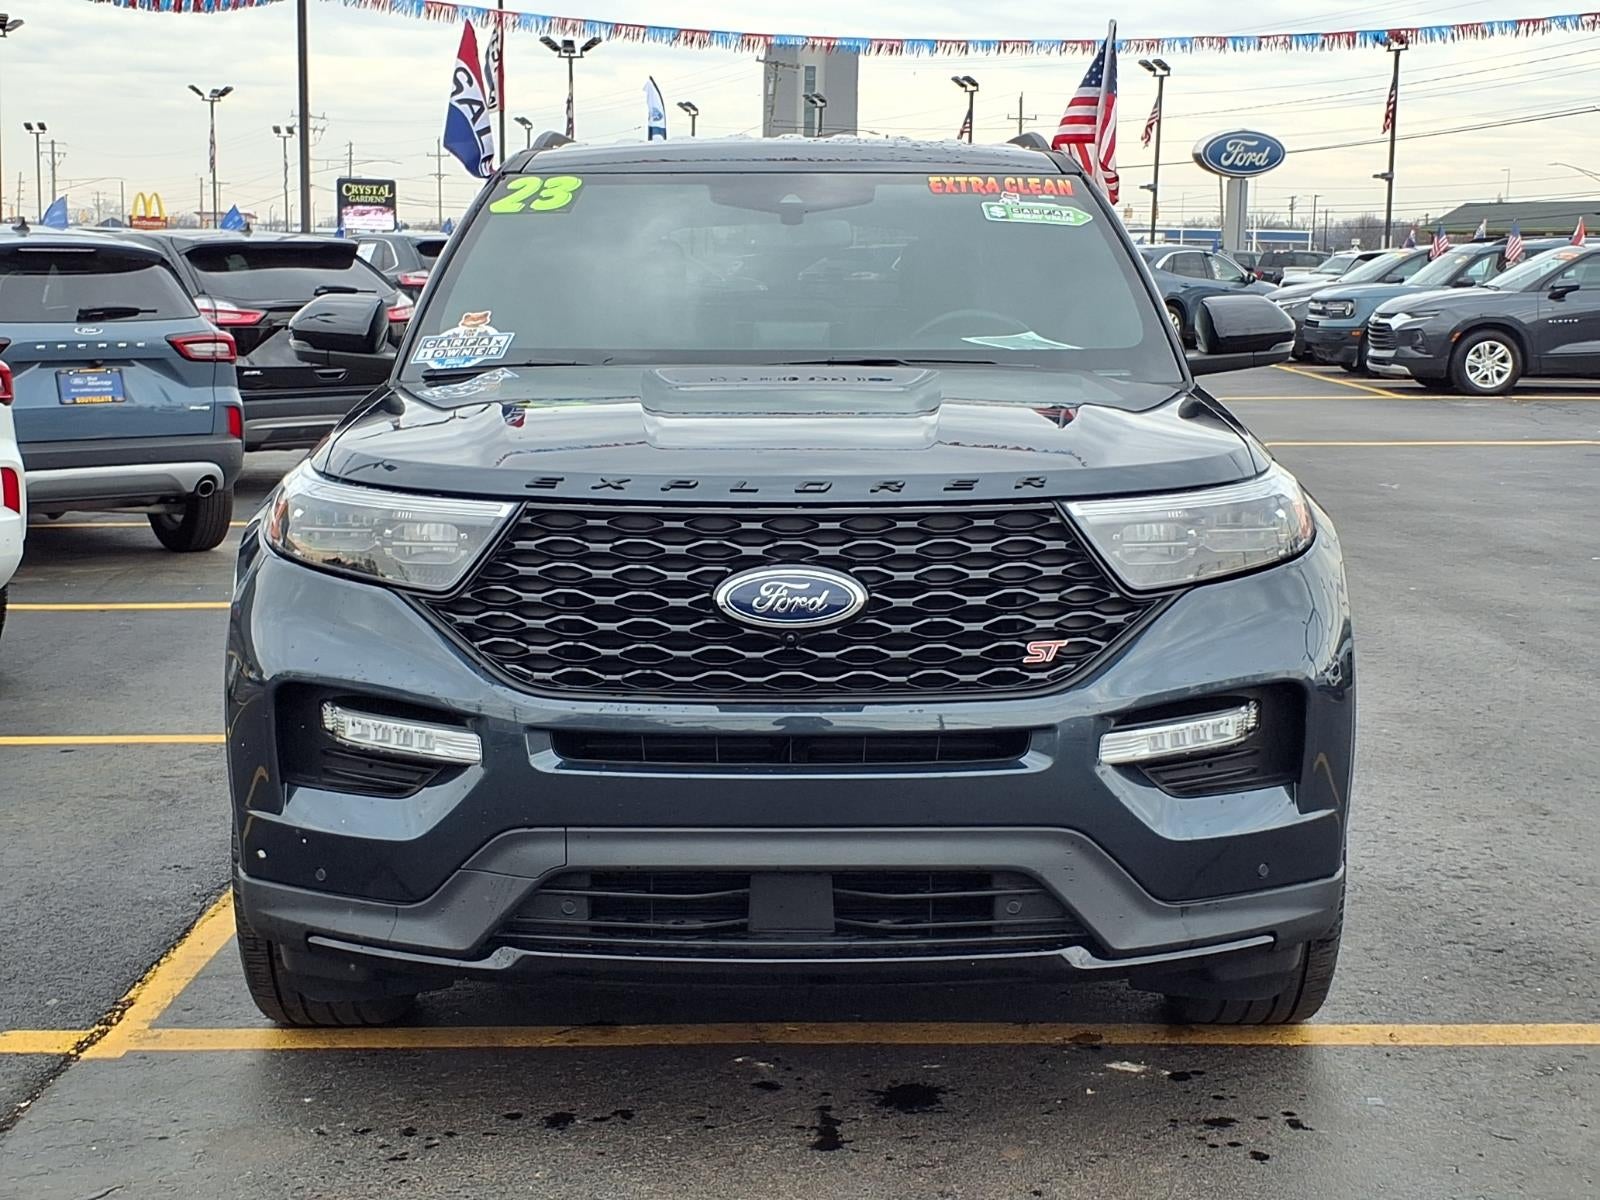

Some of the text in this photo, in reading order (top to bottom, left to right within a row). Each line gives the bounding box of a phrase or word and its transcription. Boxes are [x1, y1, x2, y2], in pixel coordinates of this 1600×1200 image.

[1220, 139, 1271, 166] Ford
[342, 183, 394, 198] CRYSTAL
[489, 175, 582, 213] 23
[928, 176, 1074, 196] EXTRA CLEAN
[348, 195, 386, 203] GARDENS
[1011, 207, 1074, 218] CARFAX
[425, 336, 505, 349] CARFAX
[433, 345, 503, 359] OWNER
[524, 474, 1048, 493] EXPLORER
[751, 581, 830, 613] Ford
[1022, 640, 1069, 664] ST
